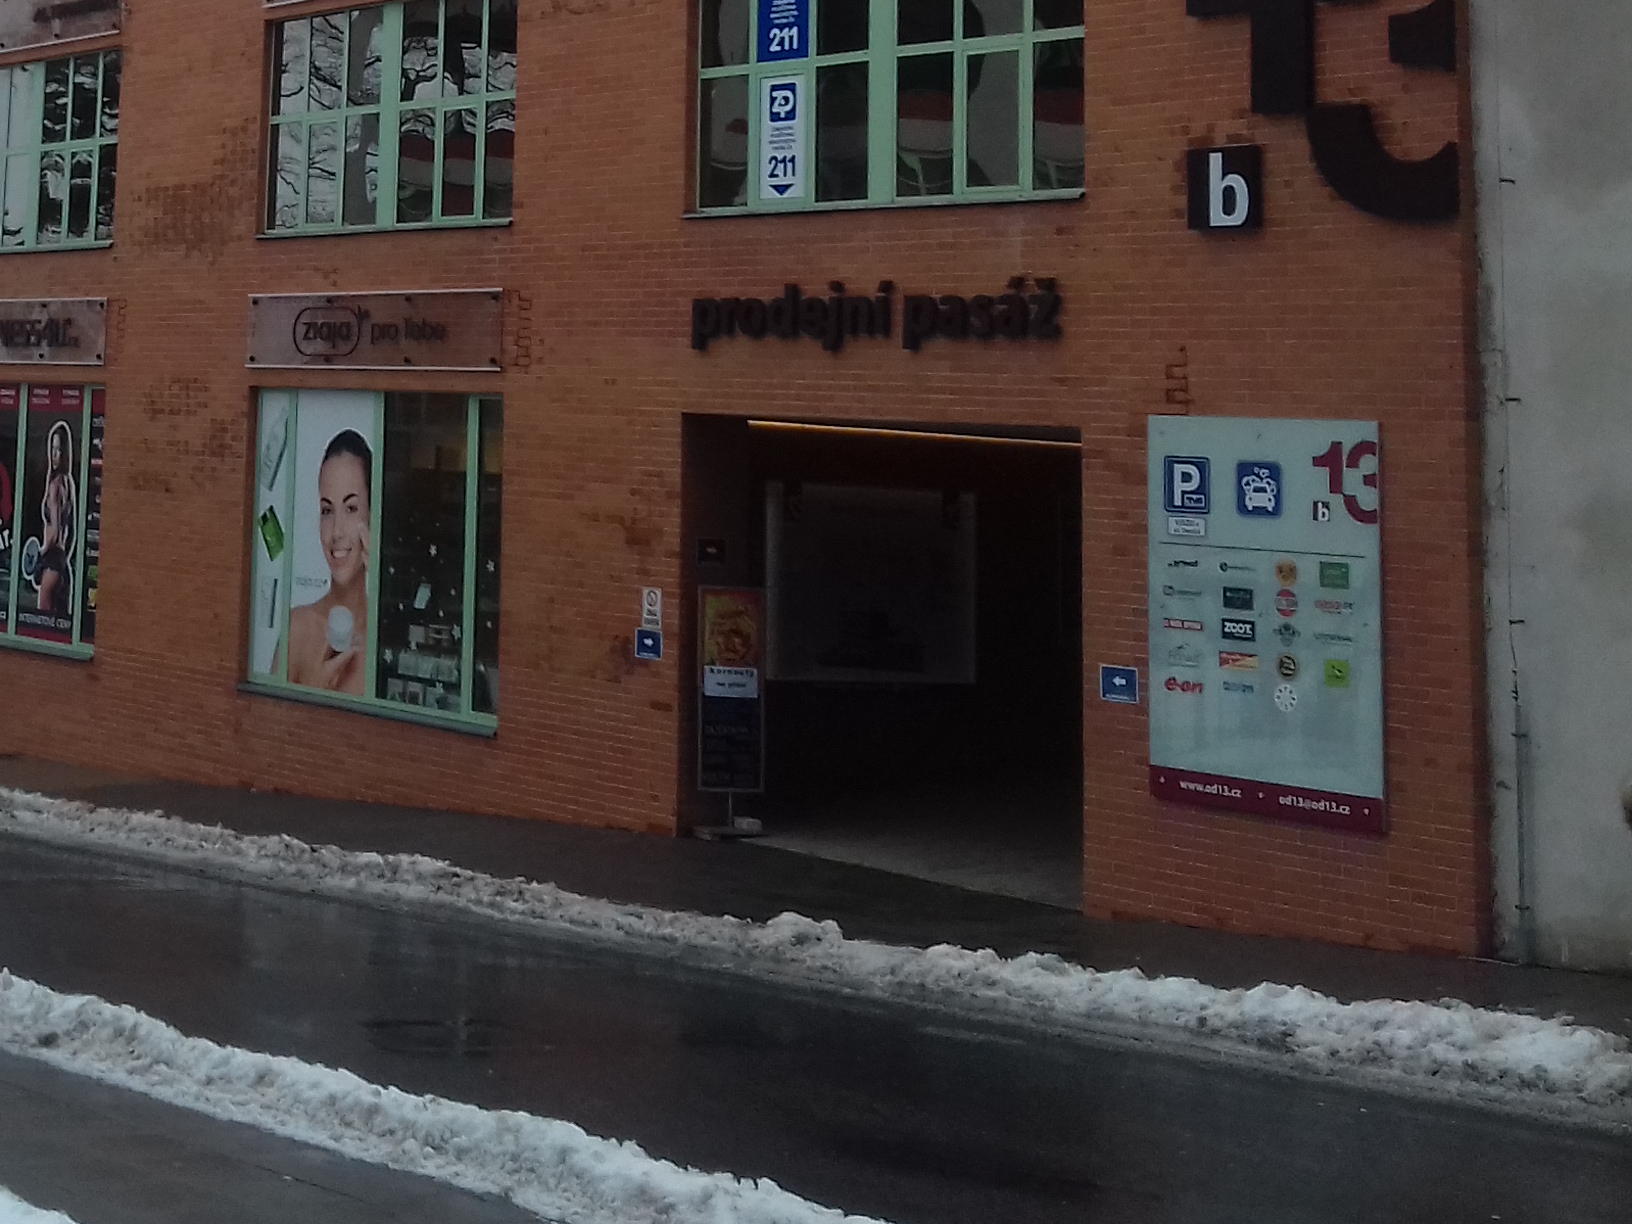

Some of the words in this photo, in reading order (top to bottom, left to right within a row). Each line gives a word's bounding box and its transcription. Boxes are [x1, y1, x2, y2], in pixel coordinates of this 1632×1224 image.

[769, 26, 799, 52] 211
[768, 155, 796, 178] 211
[1208, 152, 1248, 227] b
[691, 279, 895, 352] prodejní
[902, 275, 1063, 351] pasáž
[1173, 463, 1200, 506] P
[1312, 440, 1378, 524] 13
[1317, 502, 1329, 521] b
[1179, 780, 1242, 798] www.od13.cz
[1278, 795, 1351, 815] od13@od13.cz
